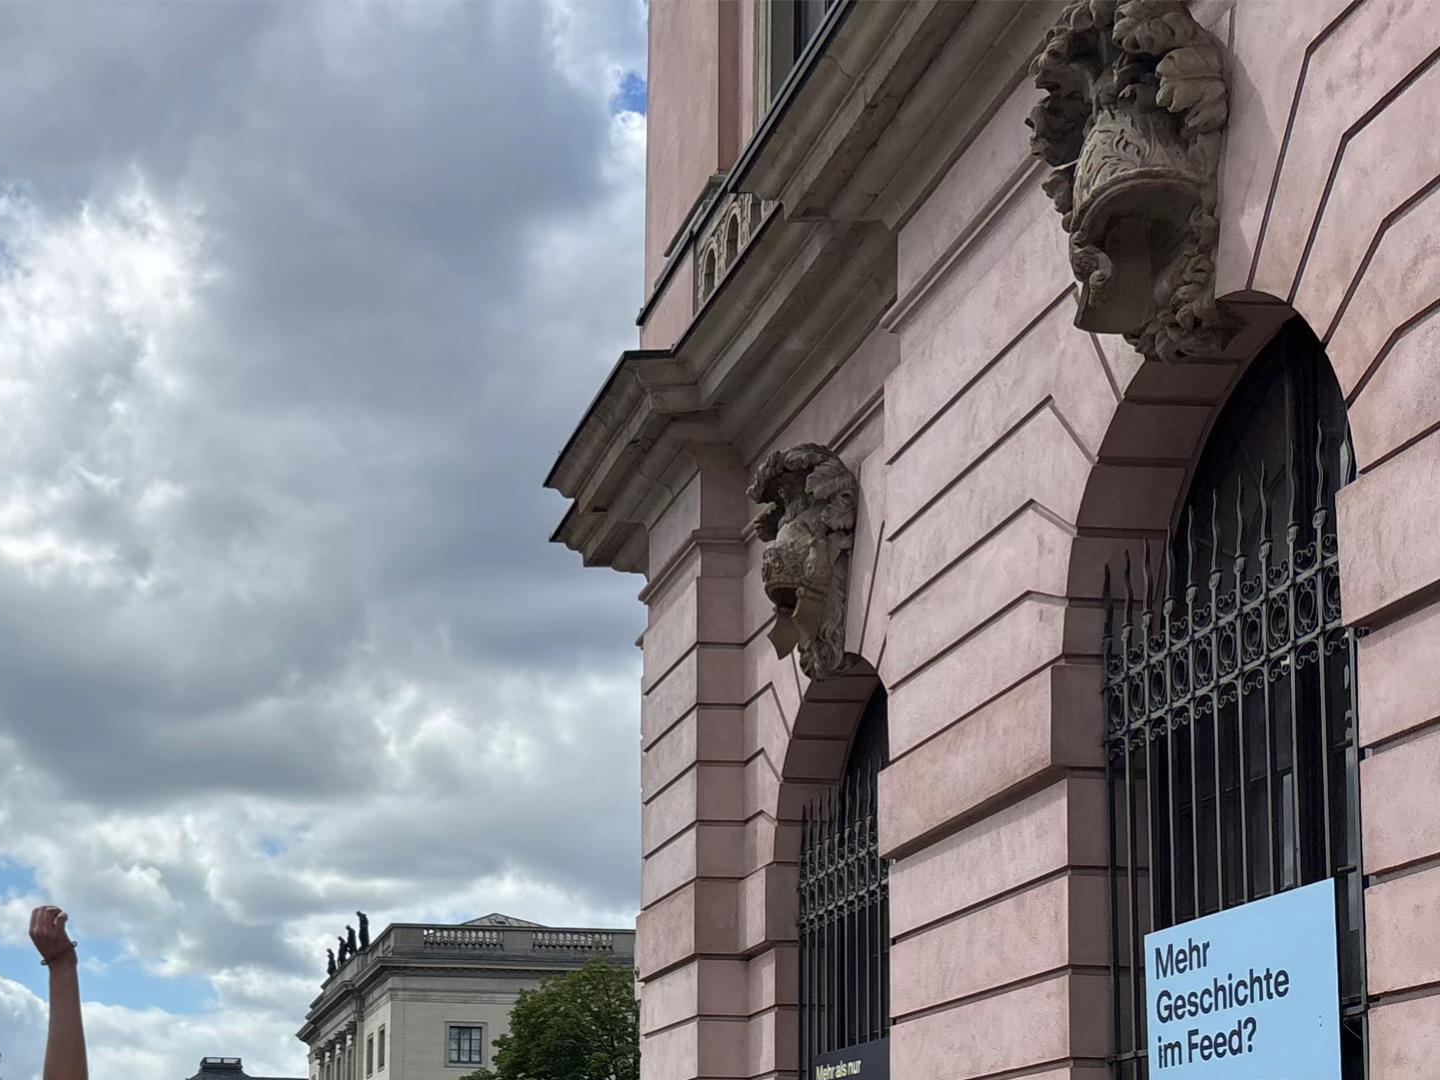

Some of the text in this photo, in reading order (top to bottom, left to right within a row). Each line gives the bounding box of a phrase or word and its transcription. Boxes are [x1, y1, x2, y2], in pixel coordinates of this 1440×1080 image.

[1155, 938, 1210, 980] Mehr
[1156, 968, 1290, 1024] Geschichte
[1158, 1016, 1257, 1069] im Feed?
[835, 1060, 847, 1078] als
[847, 1060, 862, 1076] nur
